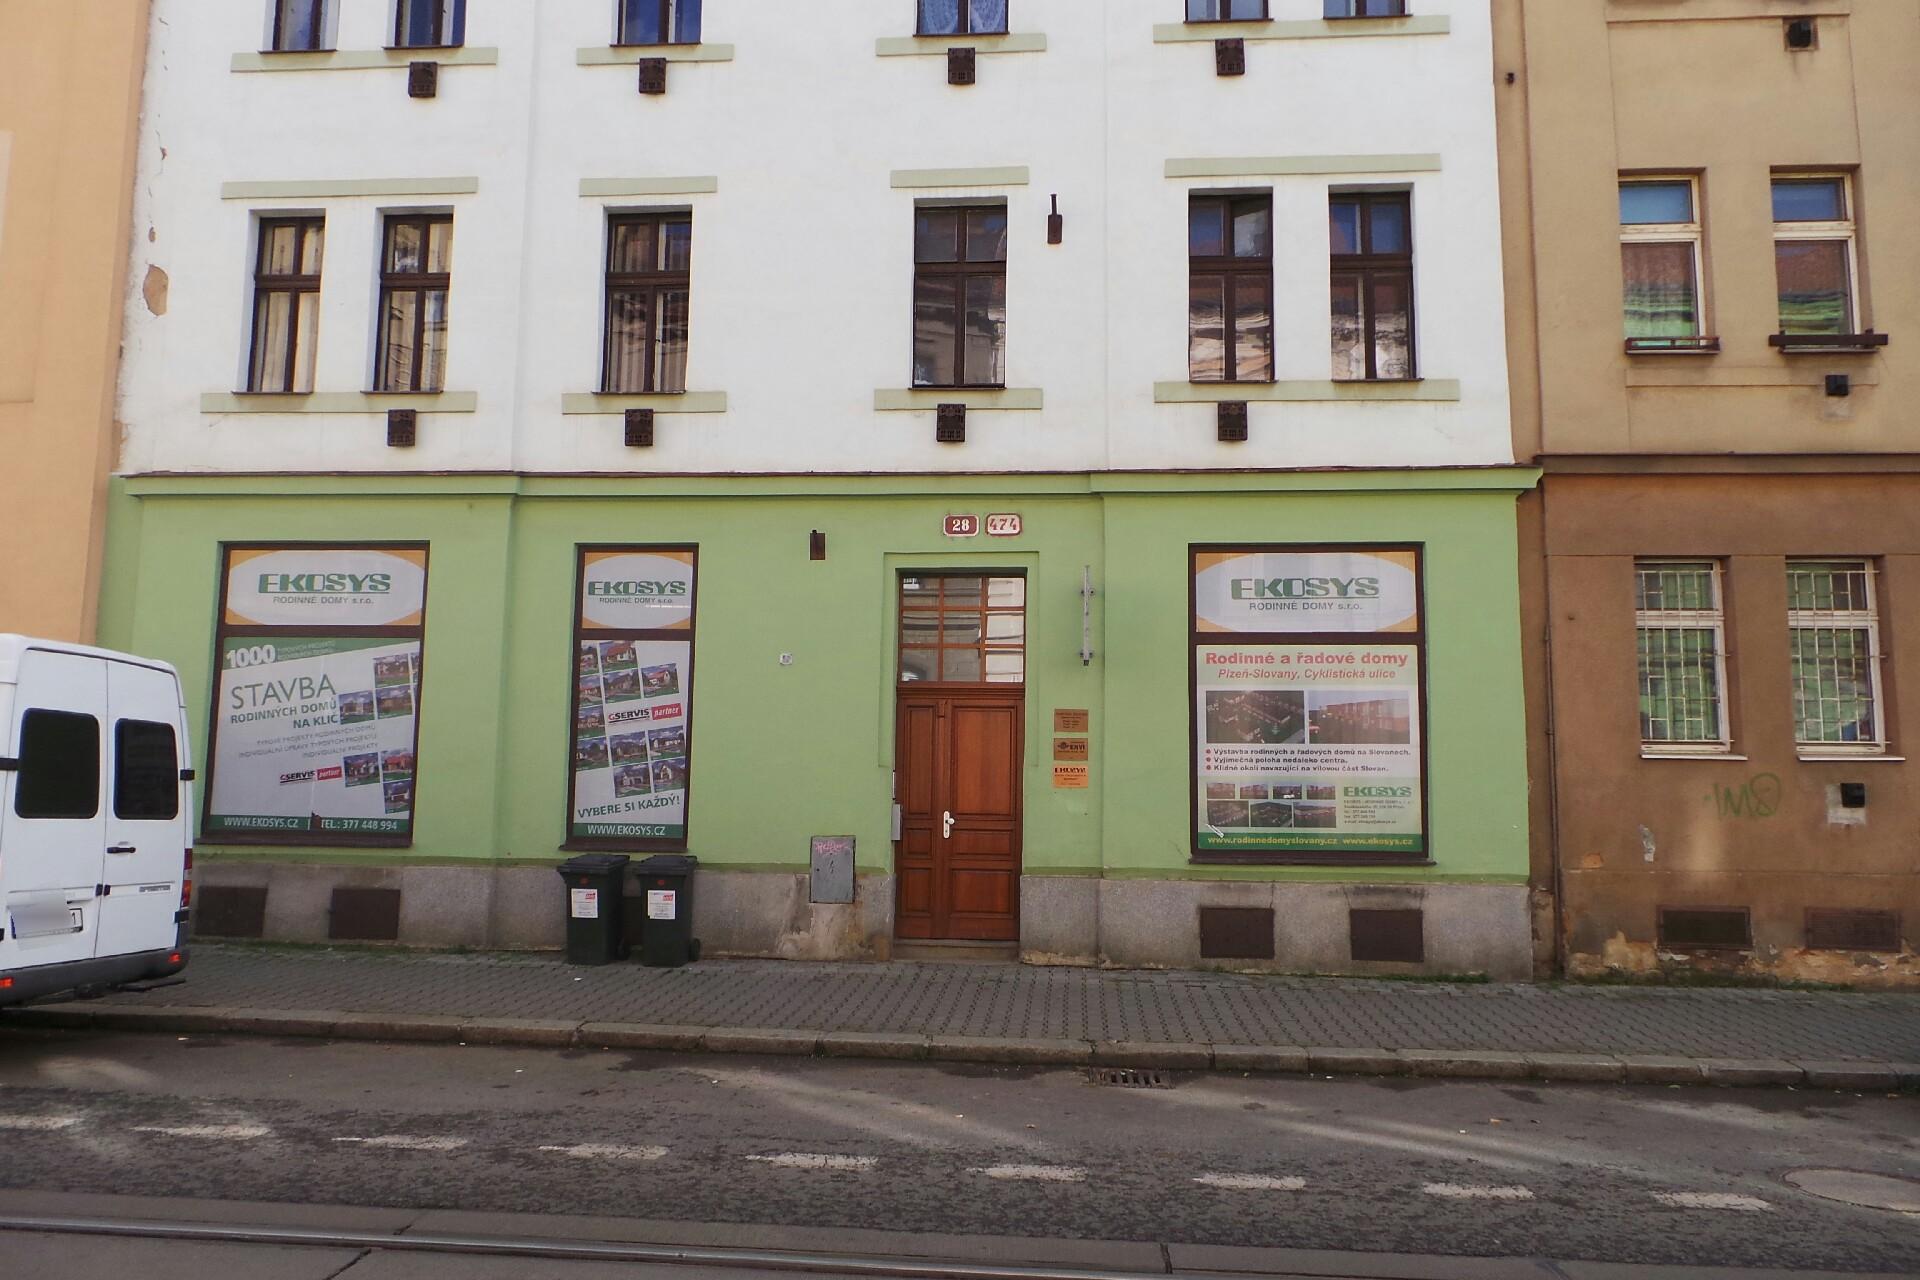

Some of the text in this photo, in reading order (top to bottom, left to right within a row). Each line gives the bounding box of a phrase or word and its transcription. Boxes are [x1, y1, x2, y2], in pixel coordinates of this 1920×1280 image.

[952, 518, 970, 531] 28
[989, 518, 1017, 530] 474
[258, 573, 391, 594] EKOSYS
[588, 580, 686, 596] EKOSYS
[1231, 577, 1379, 599] EKOSYS
[321, 596, 348, 604] DOMY
[1249, 600, 1298, 610] RODINNÉ
[1302, 602, 1333, 610] DOMY
[226, 644, 277, 669] 1000
[1206, 651, 1408, 667] Rodinné a řadové domy
[1218, 668, 1395, 680] Plzeň-Slovany, Cyklistická ulice
[231, 674, 337, 710] STAVBA
[230, 697, 337, 724] RODINNÝCH DOMŮ
[654, 706, 680, 718] partner
[293, 717, 310, 729] NA
[1214, 748, 1249, 756] Výstavba
[1250, 748, 1288, 756] rodinných
[1297, 748, 1332, 756] řadových
[1261, 764, 1299, 772] navazující
[1344, 786, 1412, 797] EKOSYS
[578, 793, 680, 818] VYBERE SI KAŽDÝ!
[224, 816, 299, 828] WWW.EKOSYS.CZ
[343, 819, 358, 829] 377
[361, 820, 378, 829] 448
[380, 820, 398, 830] 994
[587, 824, 665, 836] WWW.EKOSYS.CZ
[1207, 837, 1413, 846] www.rodinnedomyslovany.cz www.ekosys.cz
